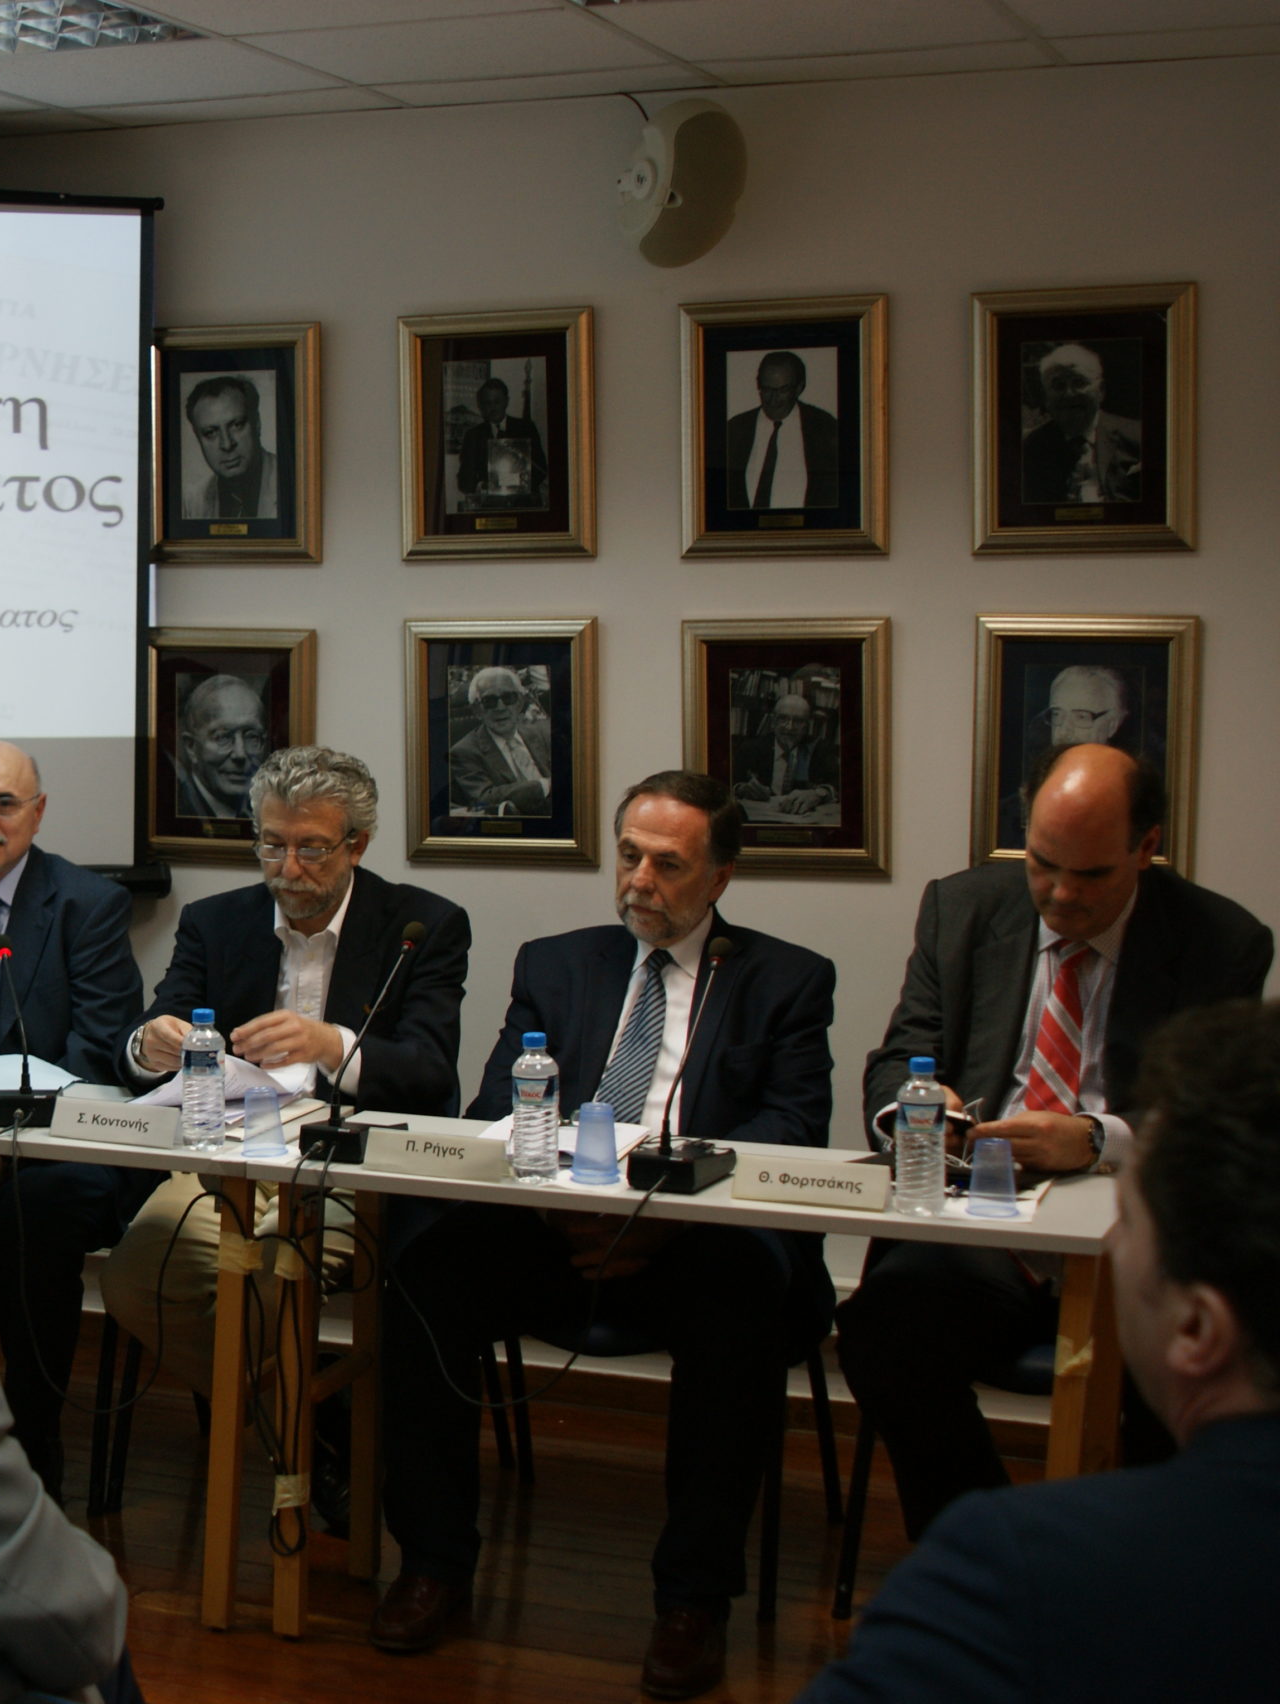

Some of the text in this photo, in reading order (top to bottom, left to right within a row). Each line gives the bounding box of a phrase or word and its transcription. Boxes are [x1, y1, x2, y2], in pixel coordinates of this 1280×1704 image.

[77, 1112, 149, 1133] Σ. Κοντονής
[405, 1140, 465, 1160] Π. Ρήγας
[758, 1171, 863, 1195] Θ. Φορτσάκης
